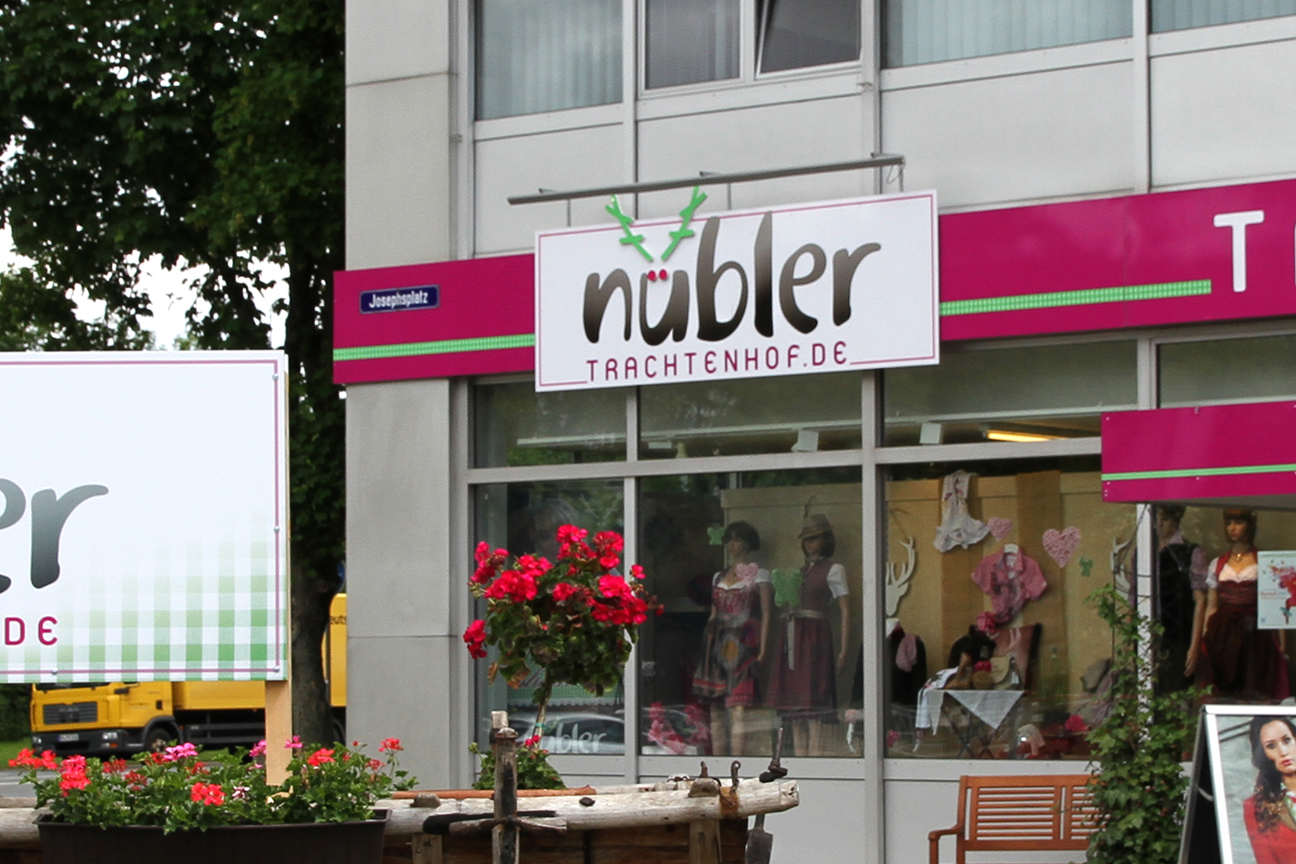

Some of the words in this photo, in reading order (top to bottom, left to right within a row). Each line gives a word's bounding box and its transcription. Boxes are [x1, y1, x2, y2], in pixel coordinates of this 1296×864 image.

[583, 211, 882, 346] nübler
[368, 289, 429, 310] Josephsplatz
[586, 341, 848, 382] TRACHTENHOF.DE
